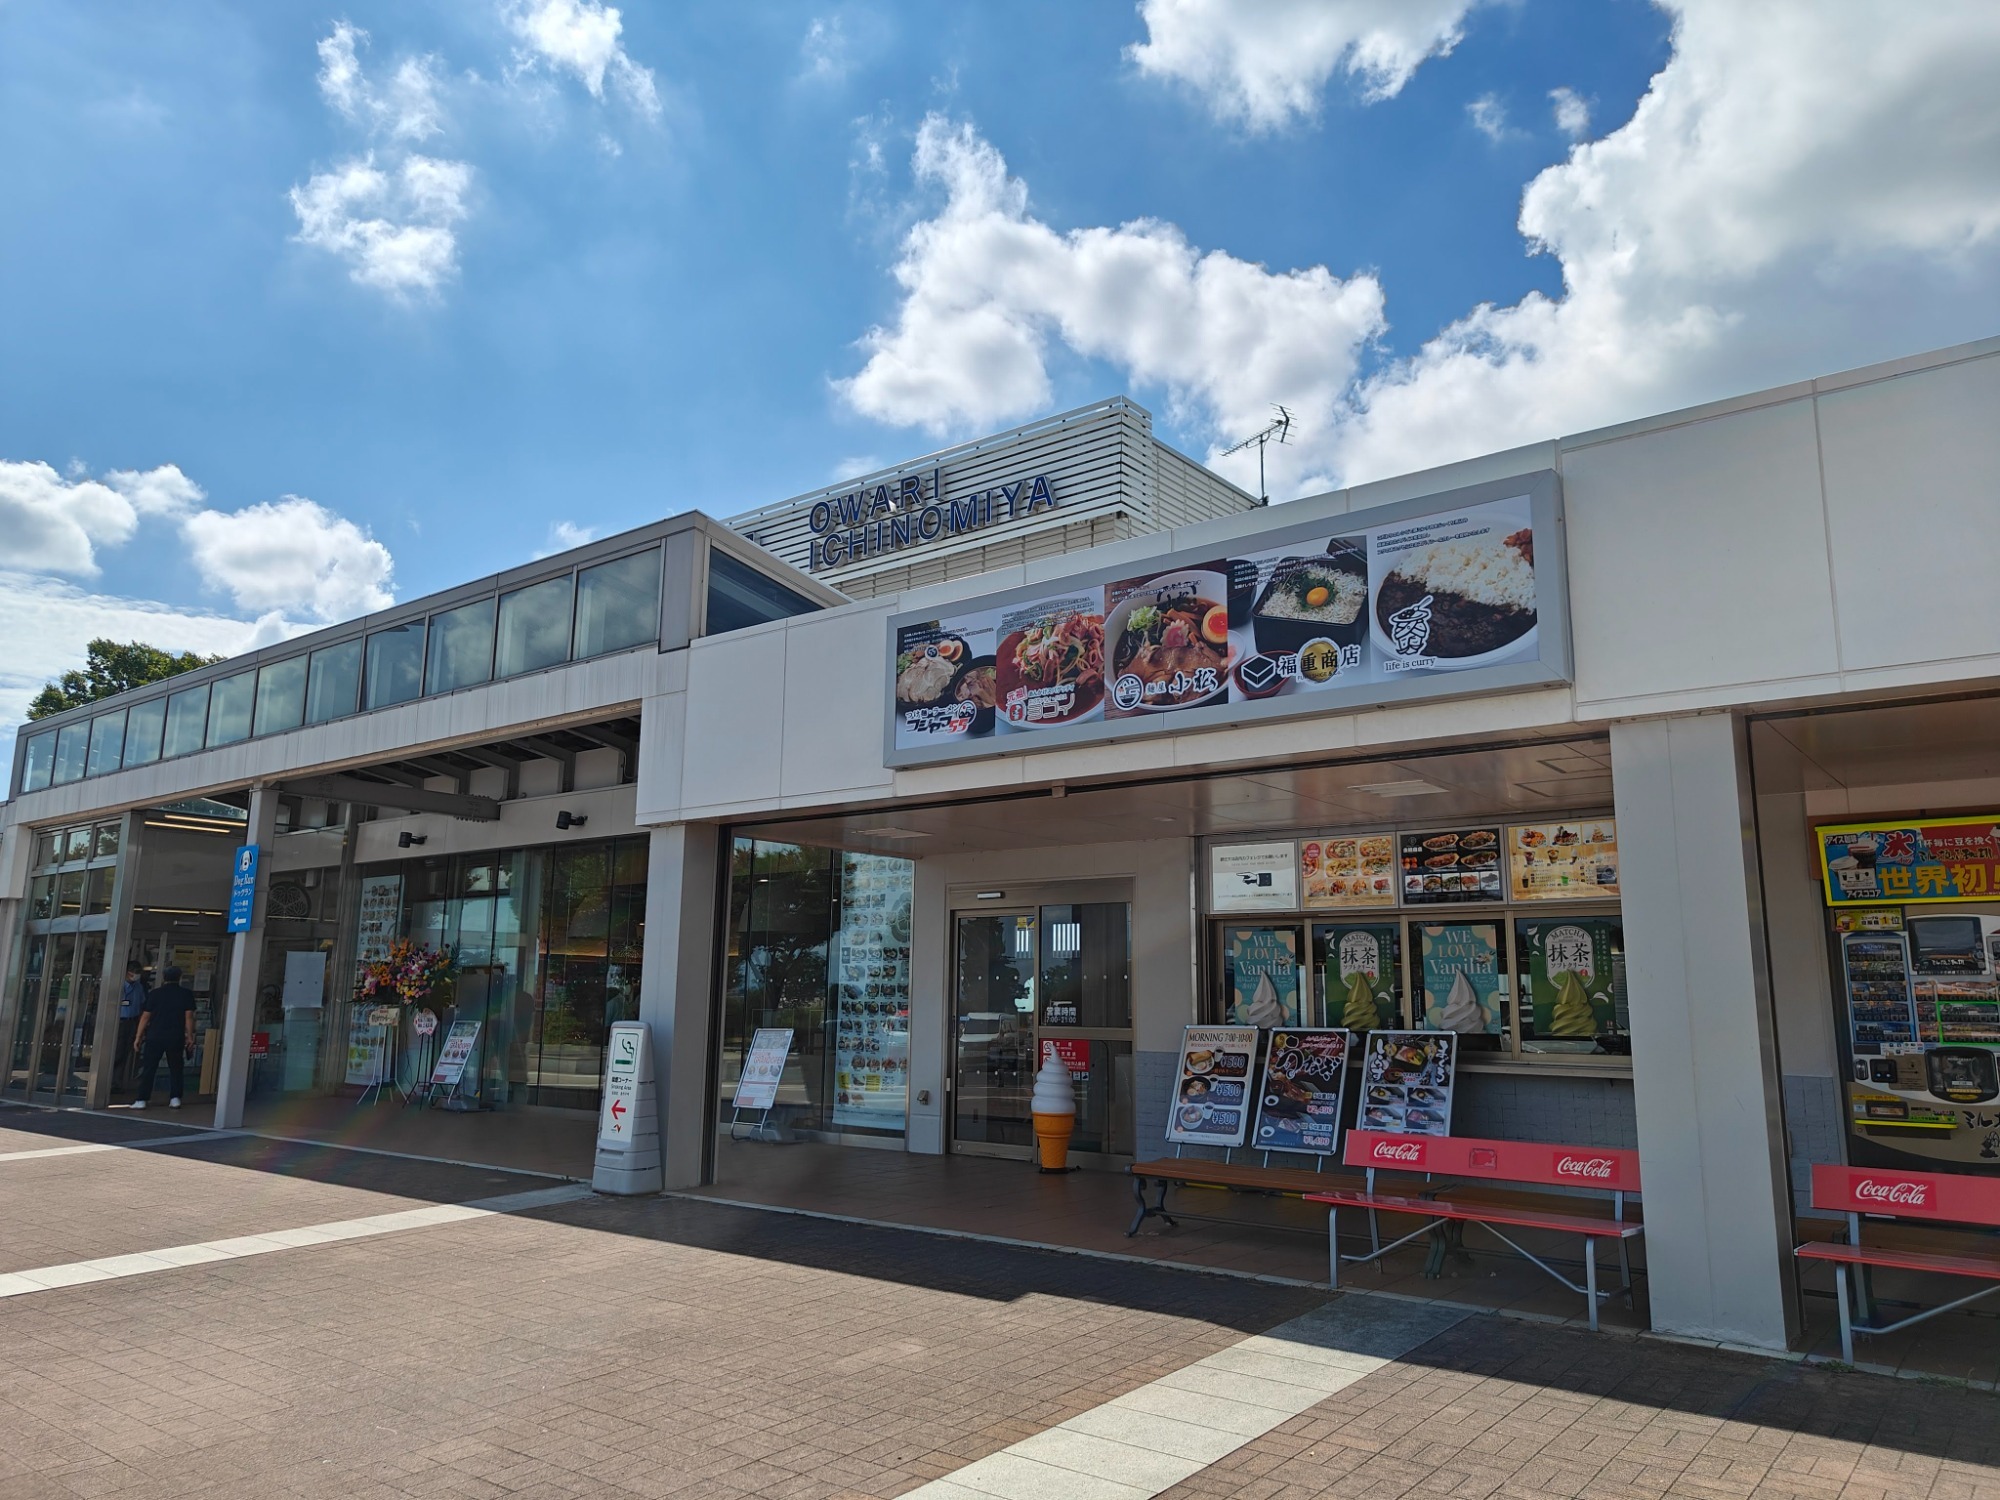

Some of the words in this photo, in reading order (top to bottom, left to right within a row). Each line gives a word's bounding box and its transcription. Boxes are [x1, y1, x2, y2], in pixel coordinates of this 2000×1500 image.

[809, 468, 941, 535] OWARI
[809, 475, 1055, 571] ICHINOMIYA
[1279, 647, 1360, 675] 福重商店
[1385, 661, 1400, 671] life
[1402, 660, 1410, 669] is
[1411, 658, 1436, 669] curry
[1169, 668, 1218, 693] 小松
[1883, 831, 1914, 858] 氷
[234, 875, 244, 887] Dog
[234, 888, 253, 897] ドッグラン
[1846, 889, 1881, 898] アイスココア
[1253, 935, 1275, 947] WE
[1345, 934, 1373, 944] MATCHA
[1445, 930, 1472, 944] WE
[1551, 929, 1585, 940] MATCHA
[1247, 947, 1281, 960] LOVE
[1341, 946, 1377, 965] 抹茶
[1438, 943, 1480, 958] LOVE
[1548, 943, 1590, 962] 抹茶
[1239, 959, 1292, 976] Vanilla
[1429, 957, 1493, 975] Vanilla
[1046, 1006, 1077, 1017] 営業時間
[1188, 1032, 1224, 1042] MORNING
[1220, 1056, 1246, 1068] ¥500
[1275, 1035, 1342, 1081] うなぎ
[1435, 1039, 1450, 1083] まぐろ
[1216, 1083, 1241, 1096] ¥500
[1306, 1104, 1334, 1115] ¥2,490
[1212, 1111, 1238, 1125] ¥500
[1962, 1110, 2000, 1129] ミル
[1373, 1141, 1420, 1161] Coca-Cola
[1557, 1155, 1614, 1178] Coca-Cola
[1855, 1179, 1929, 1205] Coca-Cola
